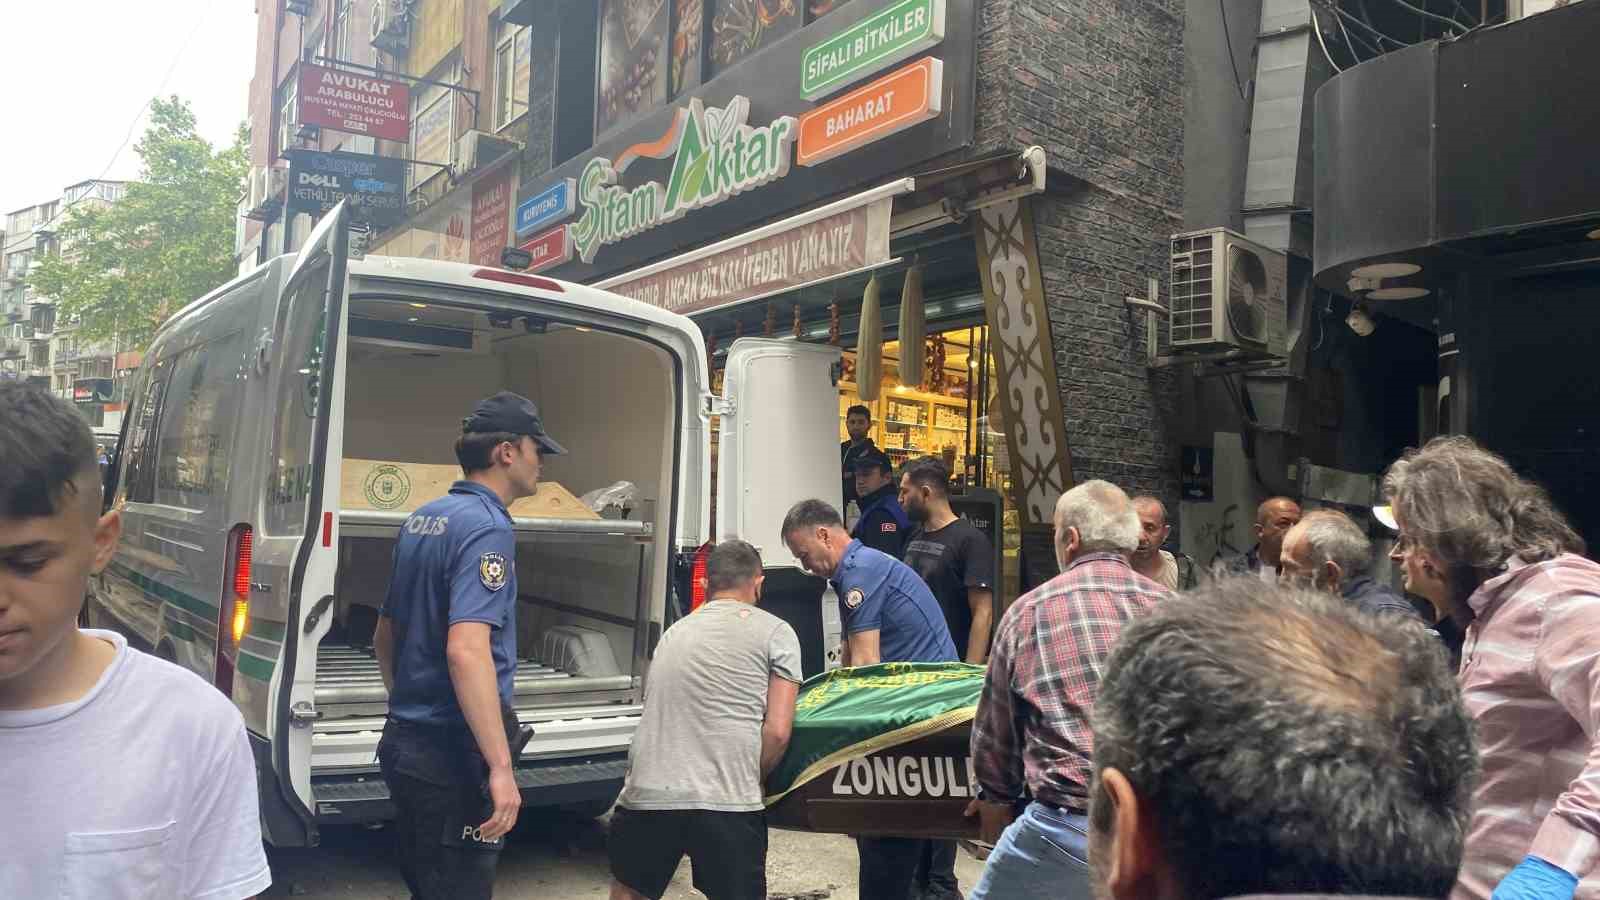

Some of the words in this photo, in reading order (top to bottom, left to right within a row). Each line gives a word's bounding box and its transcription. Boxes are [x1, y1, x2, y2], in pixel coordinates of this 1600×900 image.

[854, 6, 925, 58] BİTKİLER
[318, 86, 394, 108] ARABULUCU
[321, 71, 391, 96] AVUKAT
[825, 91, 894, 137] BAHARAT
[299, 172, 340, 188] DELL
[661, 97, 797, 220] Aktar
[664, 271, 699, 310] ANCAK
[700, 260, 720, 299] BİZ
[720, 241, 788, 296] KALİTEDEN
